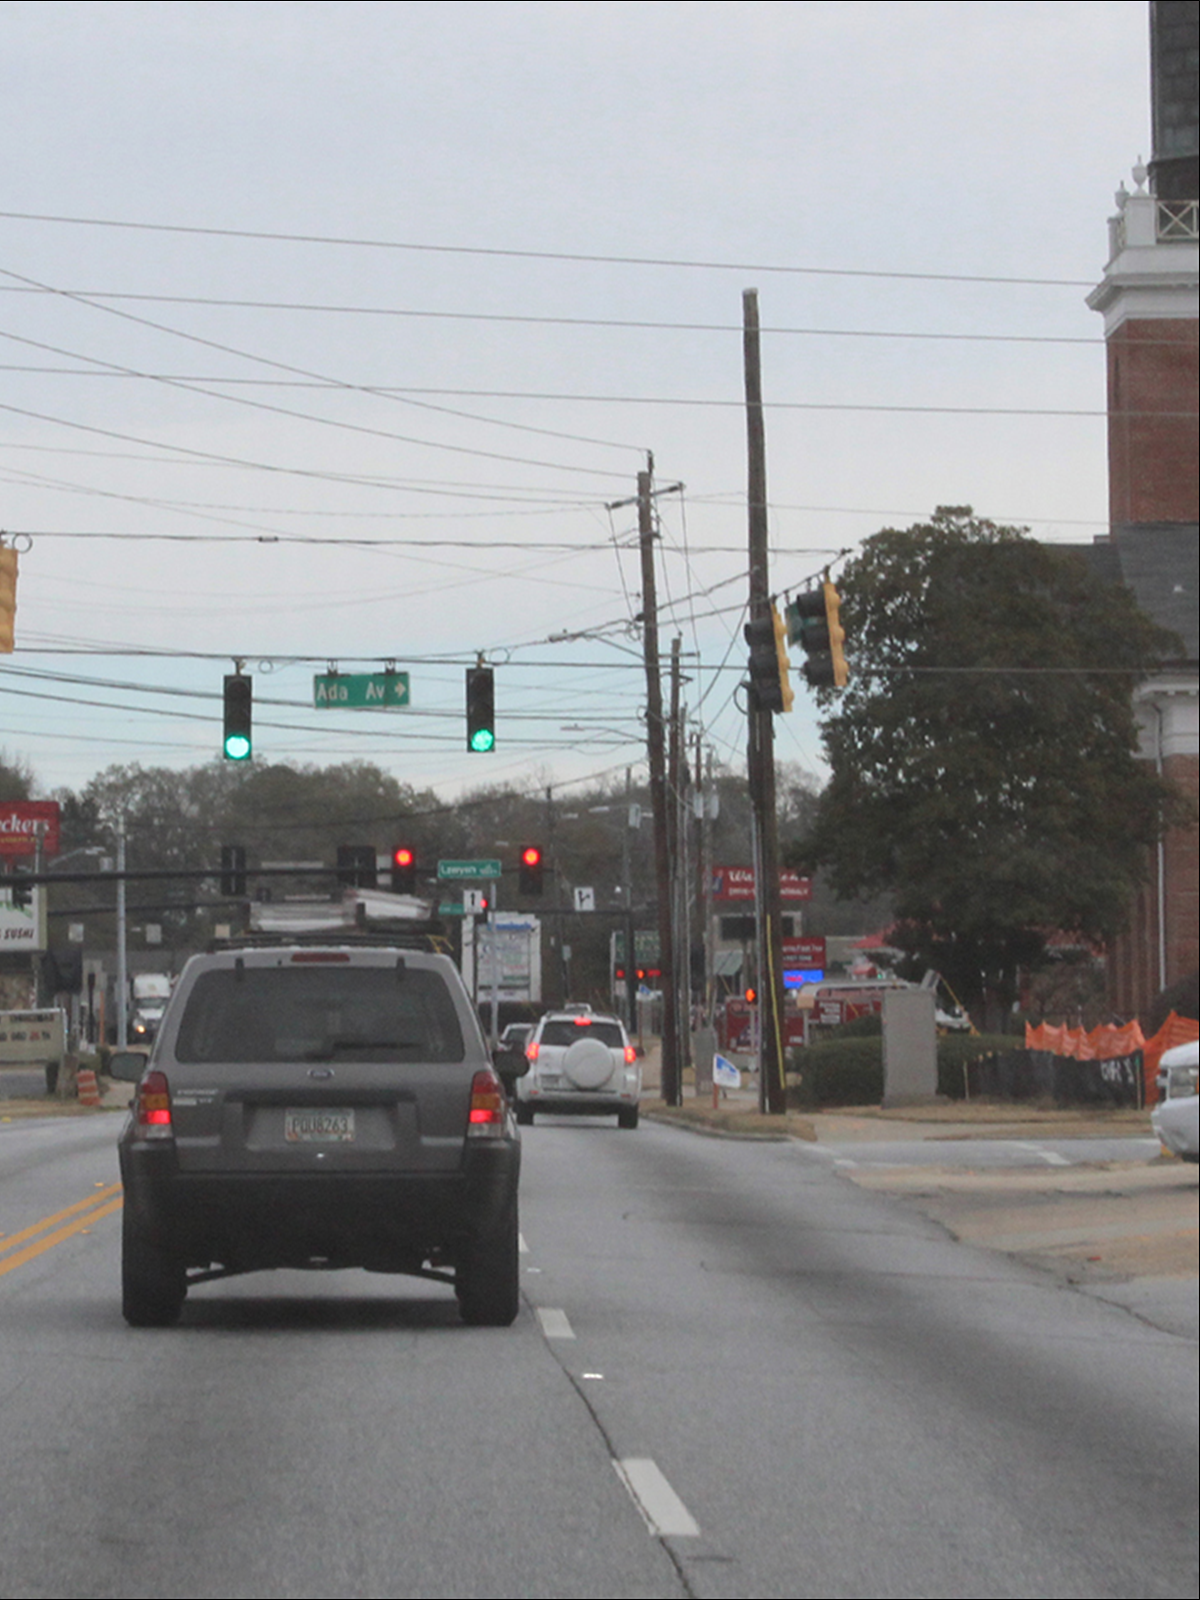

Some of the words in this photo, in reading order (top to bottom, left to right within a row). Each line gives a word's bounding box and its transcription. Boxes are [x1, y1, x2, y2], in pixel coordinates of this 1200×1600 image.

[316, 682, 349, 701] Ada
[365, 681, 386, 701] Av
[4, 927, 35, 940] SUSHI
